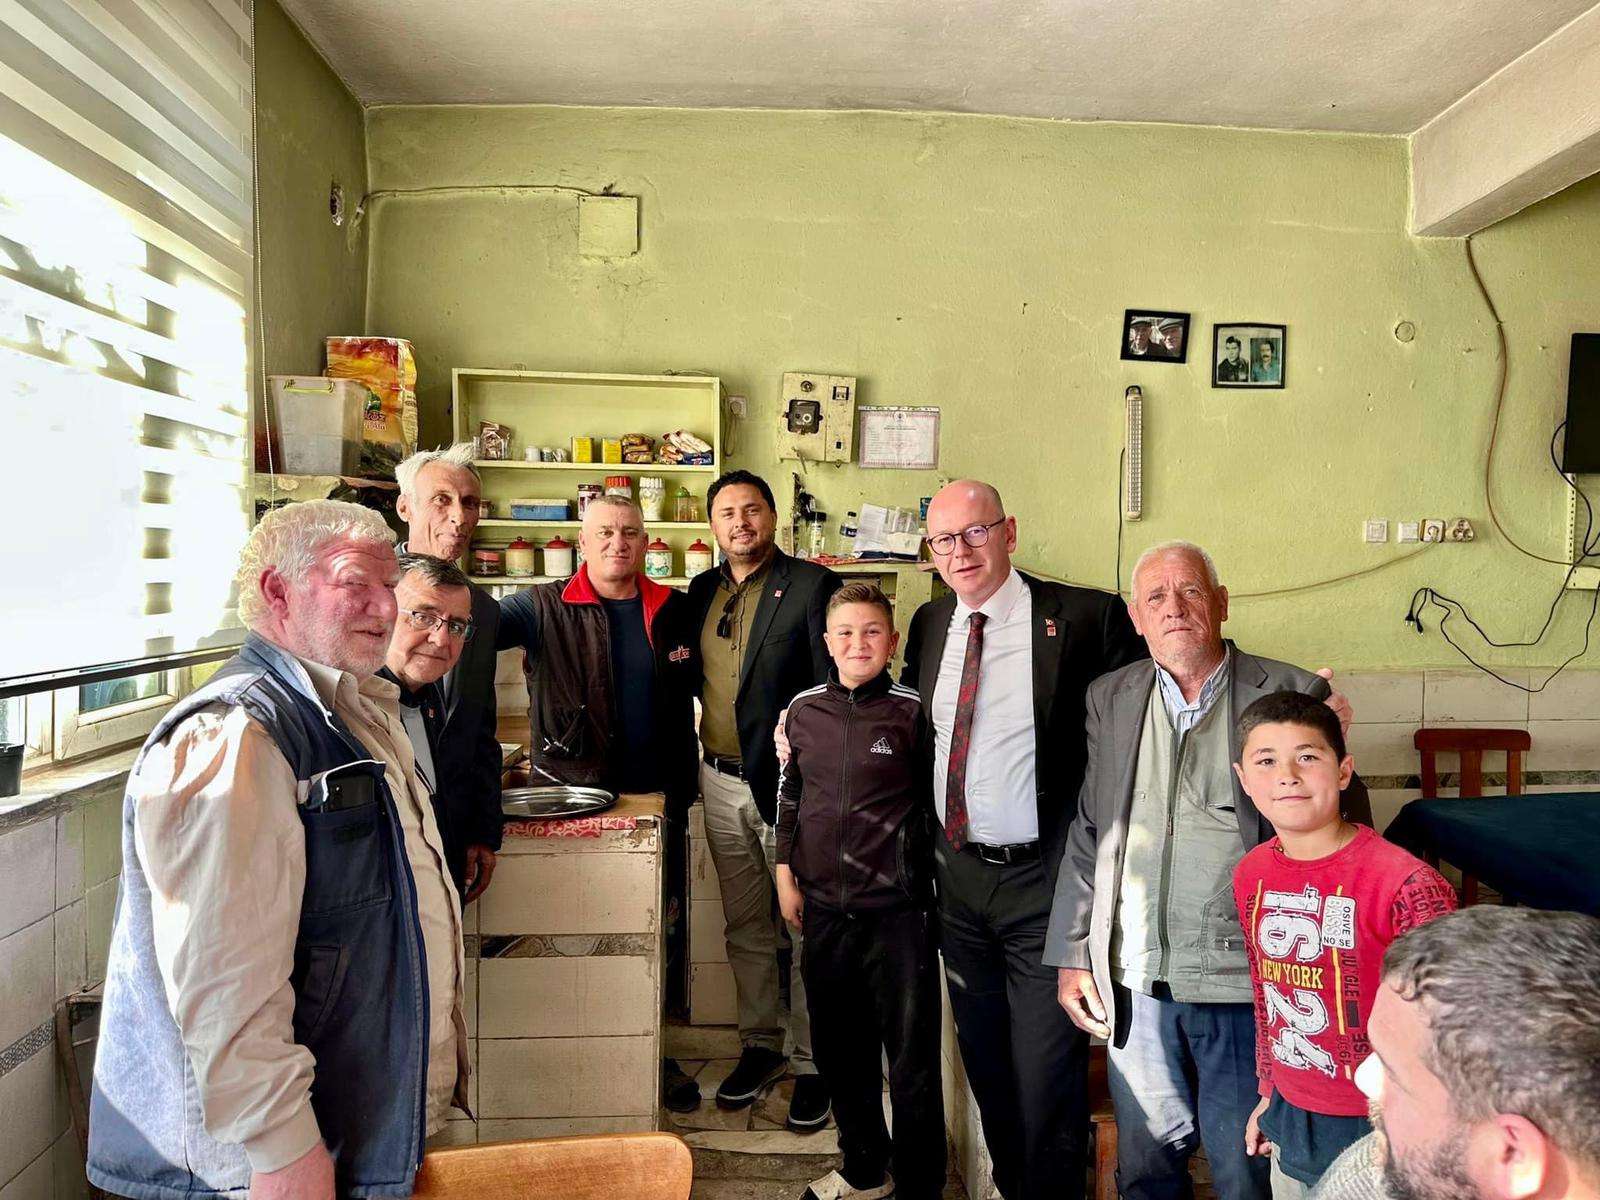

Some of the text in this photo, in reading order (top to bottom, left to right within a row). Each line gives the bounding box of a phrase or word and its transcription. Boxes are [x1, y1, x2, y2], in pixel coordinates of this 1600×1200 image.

[870, 747, 893, 755] adidas
[1262, 958, 1324, 989] NEW YORK
